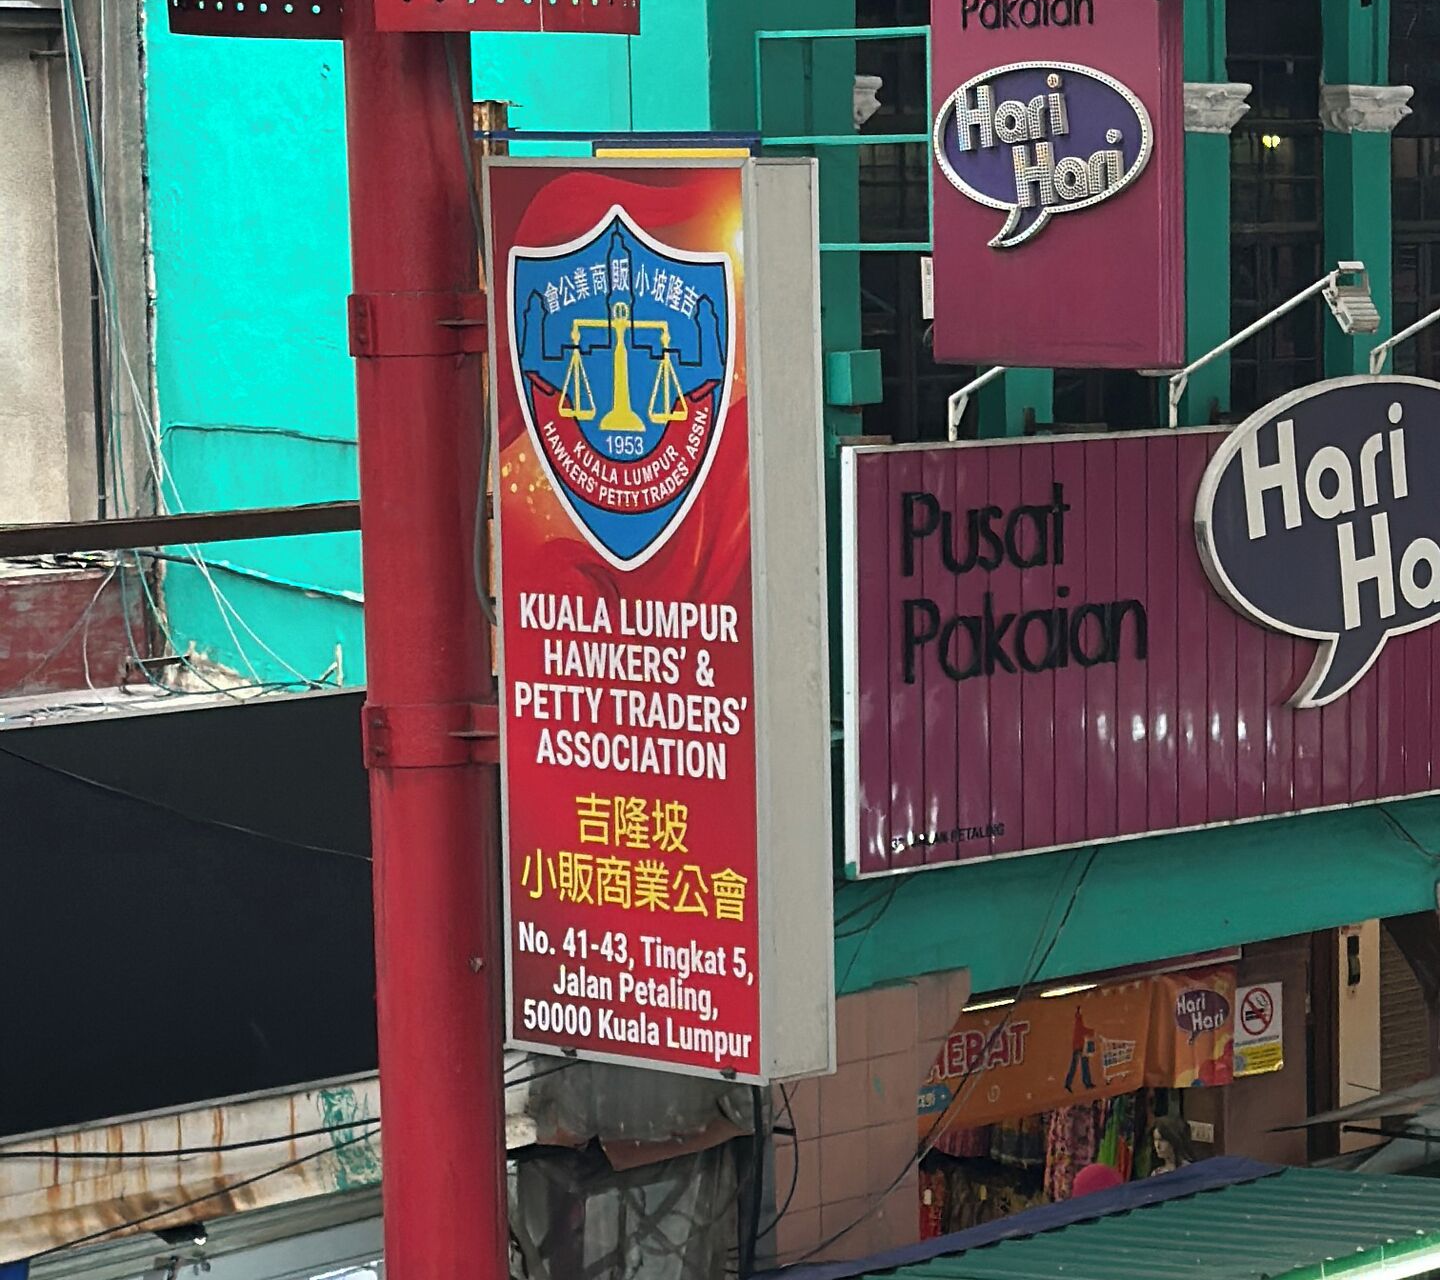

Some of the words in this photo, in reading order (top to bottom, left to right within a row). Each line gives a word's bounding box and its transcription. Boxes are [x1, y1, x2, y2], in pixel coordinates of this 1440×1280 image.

[954, 73, 1071, 152] Hari
[1012, 128, 1125, 208] Hari
[543, 421, 598, 494] HAWKERS'
[598, 485, 640, 507] PETTY
[685, 406, 709, 460] ASSN.
[573, 440, 619, 486] KUALA
[623, 445, 679, 486] LUMPUR
[606, 435, 644, 455] 1953
[1240, 402, 1410, 541] Hari
[900, 481, 1072, 578] Pusat
[519, 593, 612, 634] KUALA
[620, 599, 738, 643] LUMPUR
[902, 585, 1148, 684] Pakaian
[543, 639, 687, 685] HAWKERS'
[695, 648, 715, 689] &
[515, 682, 603, 723] PETTY
[613, 688, 748, 735] TRADERS'
[536, 728, 728, 780] ASSOCIATION
[575, 792, 689, 854] 吉隆坡
[521, 848, 748, 922] 小販商業公會
[519, 922, 556, 957] No.
[562, 927, 635, 971] 41-43,
[640, 935, 725, 980] Tingkat
[732, 946, 754, 986] 5,
[553, 964, 613, 1002] Jalan
[619, 976, 718, 1022] Petaling,
[1176, 992, 1206, 1016] Hari
[1191, 1008, 1224, 1032] Hari
[523, 999, 591, 1038] 50000
[598, 1010, 660, 1046] Kuala
[665, 1017, 752, 1062] Lumpur
